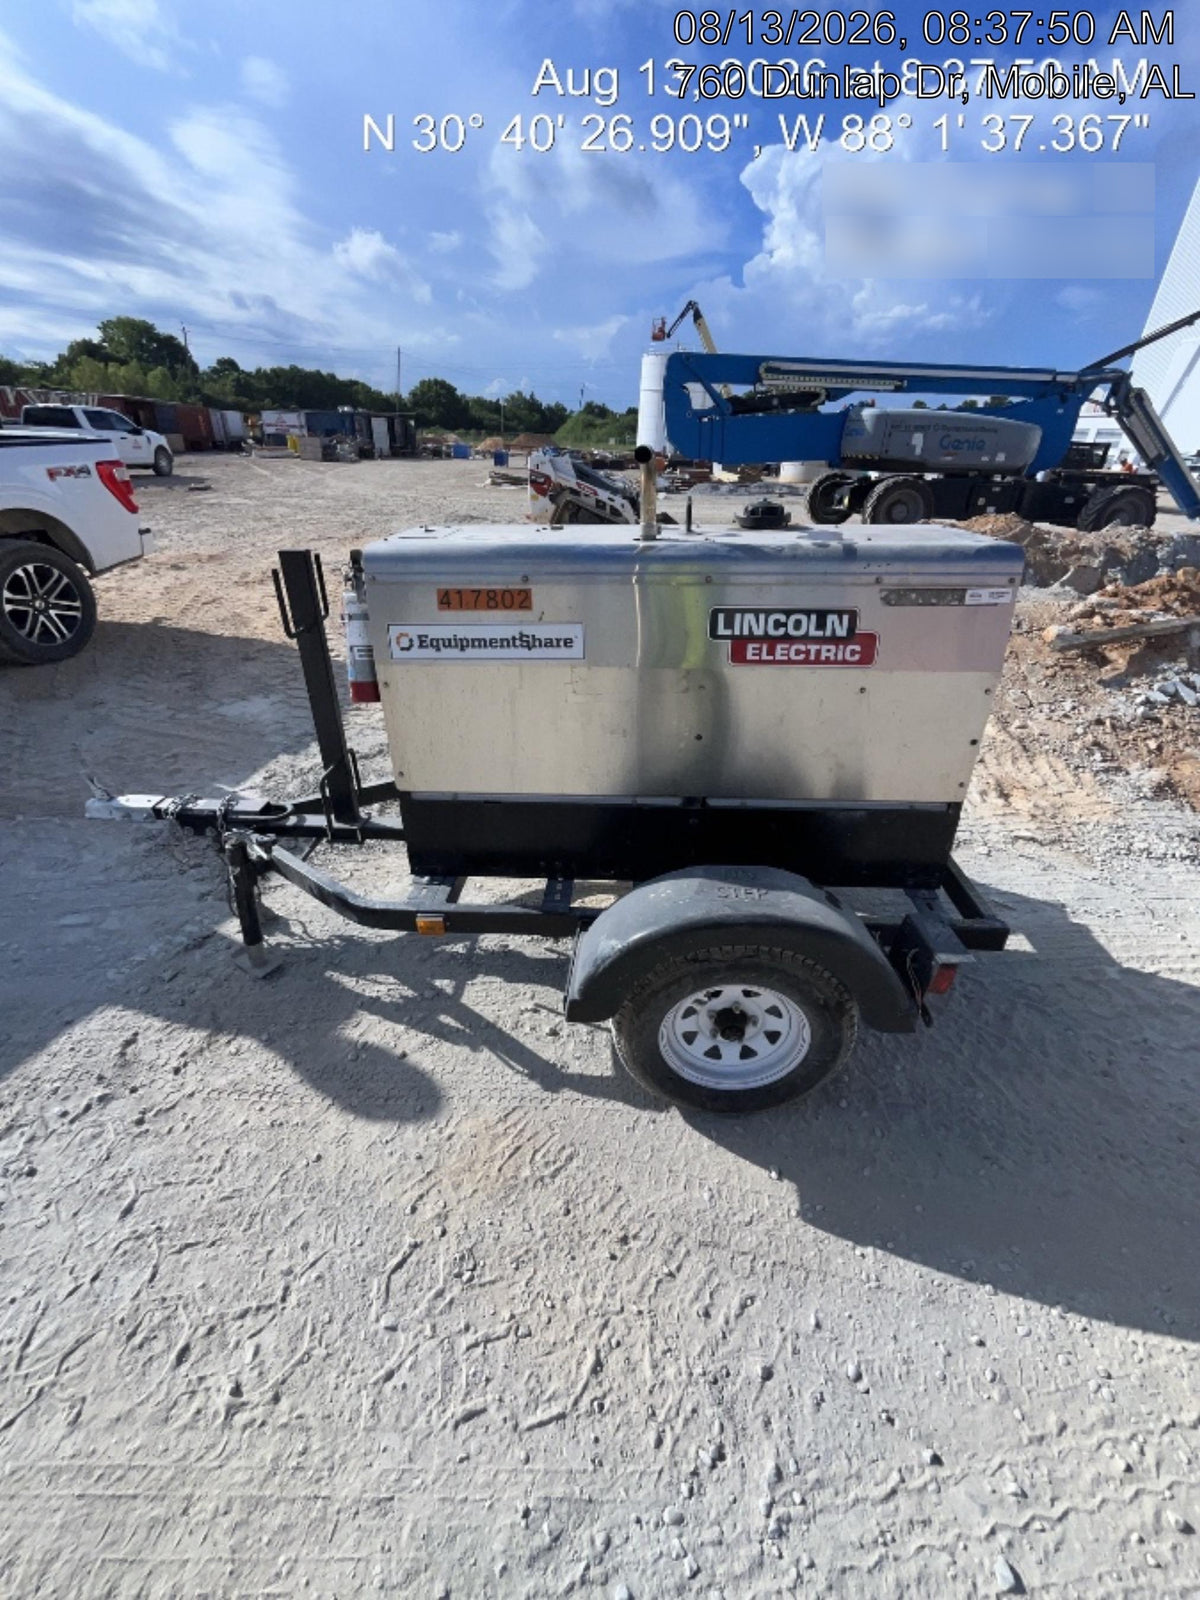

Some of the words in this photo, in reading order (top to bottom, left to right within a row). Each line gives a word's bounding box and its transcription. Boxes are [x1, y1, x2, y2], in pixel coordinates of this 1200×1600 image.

[940, 434, 986, 451] Genie
[46, 464, 91, 481] FX4
[438, 590, 531, 609] 417802
[717, 613, 850, 637] LINCOLN
[417, 633, 574, 652] EquipmentShare
[746, 643, 862, 662] ELECTRIC
